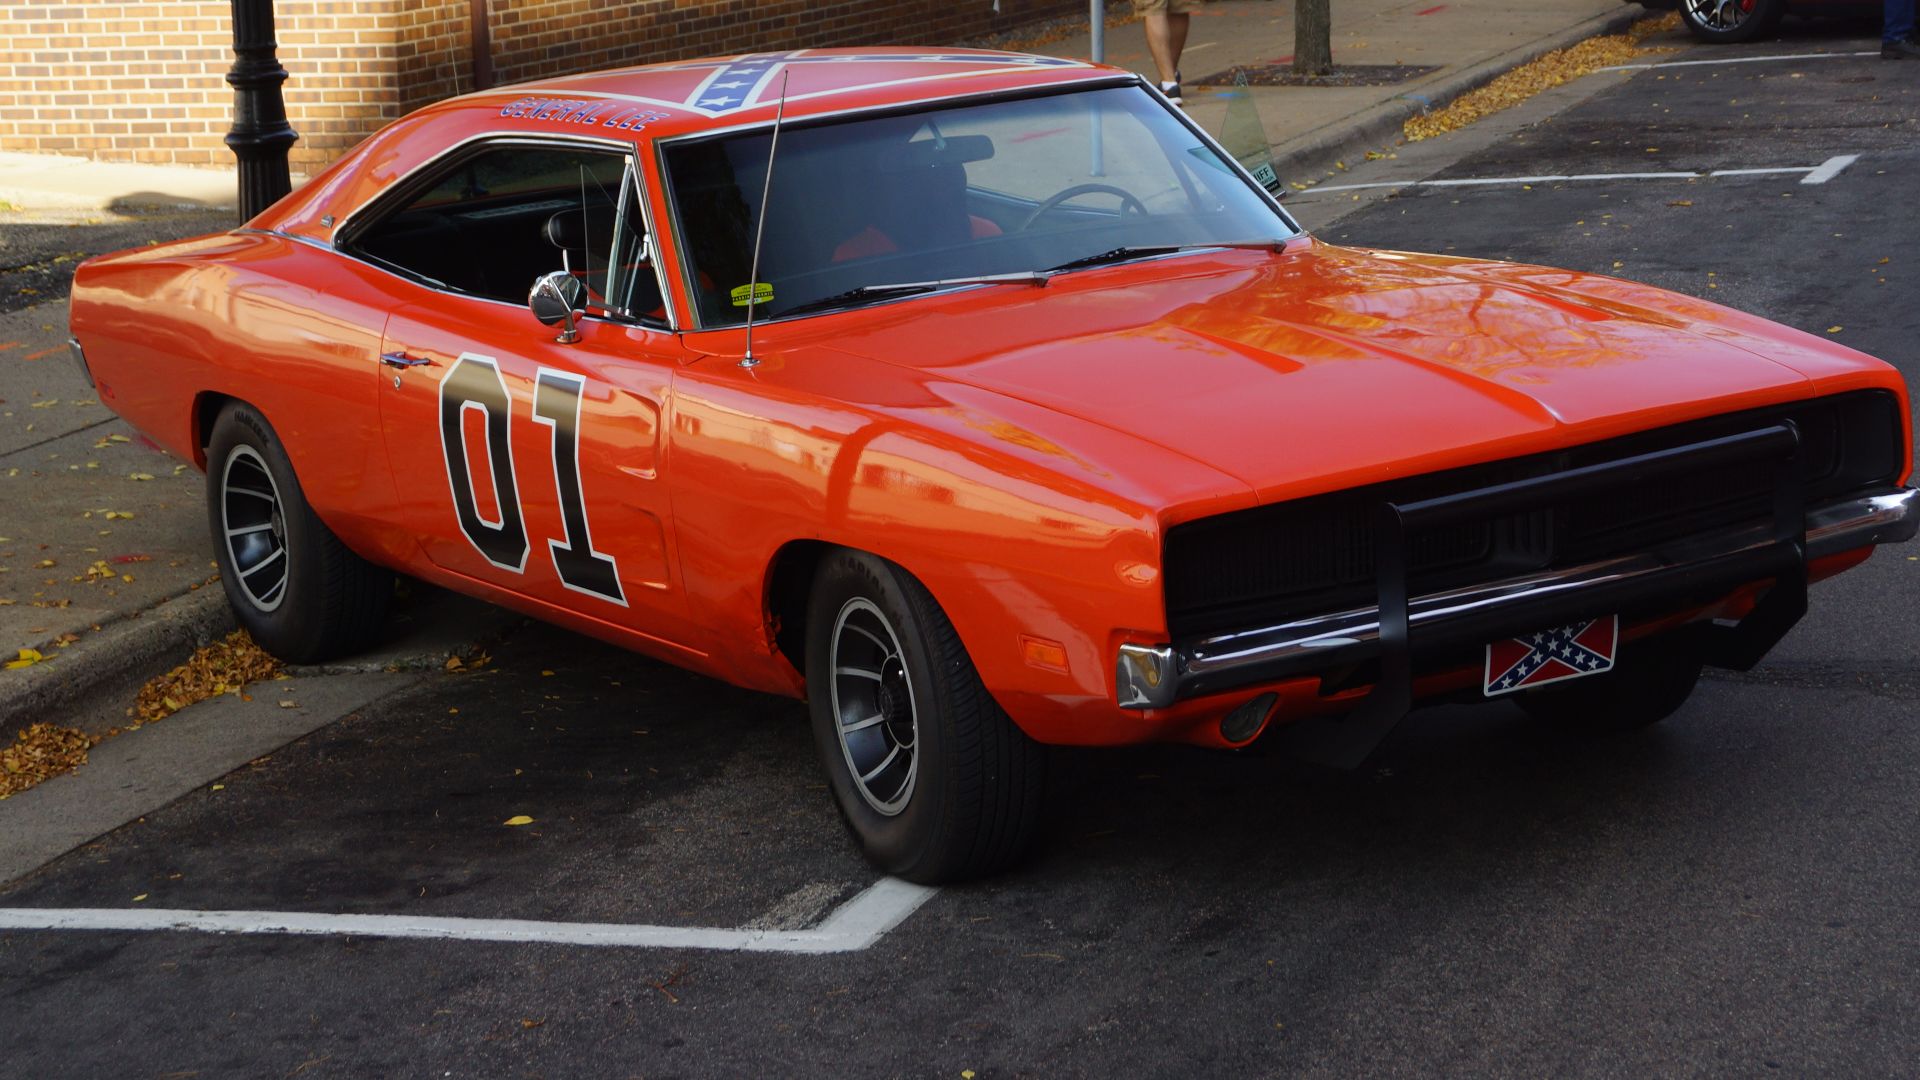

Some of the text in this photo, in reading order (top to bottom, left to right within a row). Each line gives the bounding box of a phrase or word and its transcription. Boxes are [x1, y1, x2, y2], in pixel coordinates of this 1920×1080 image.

[500, 97, 671, 132] GENERAL LEE
[438, 352, 630, 608] 01
